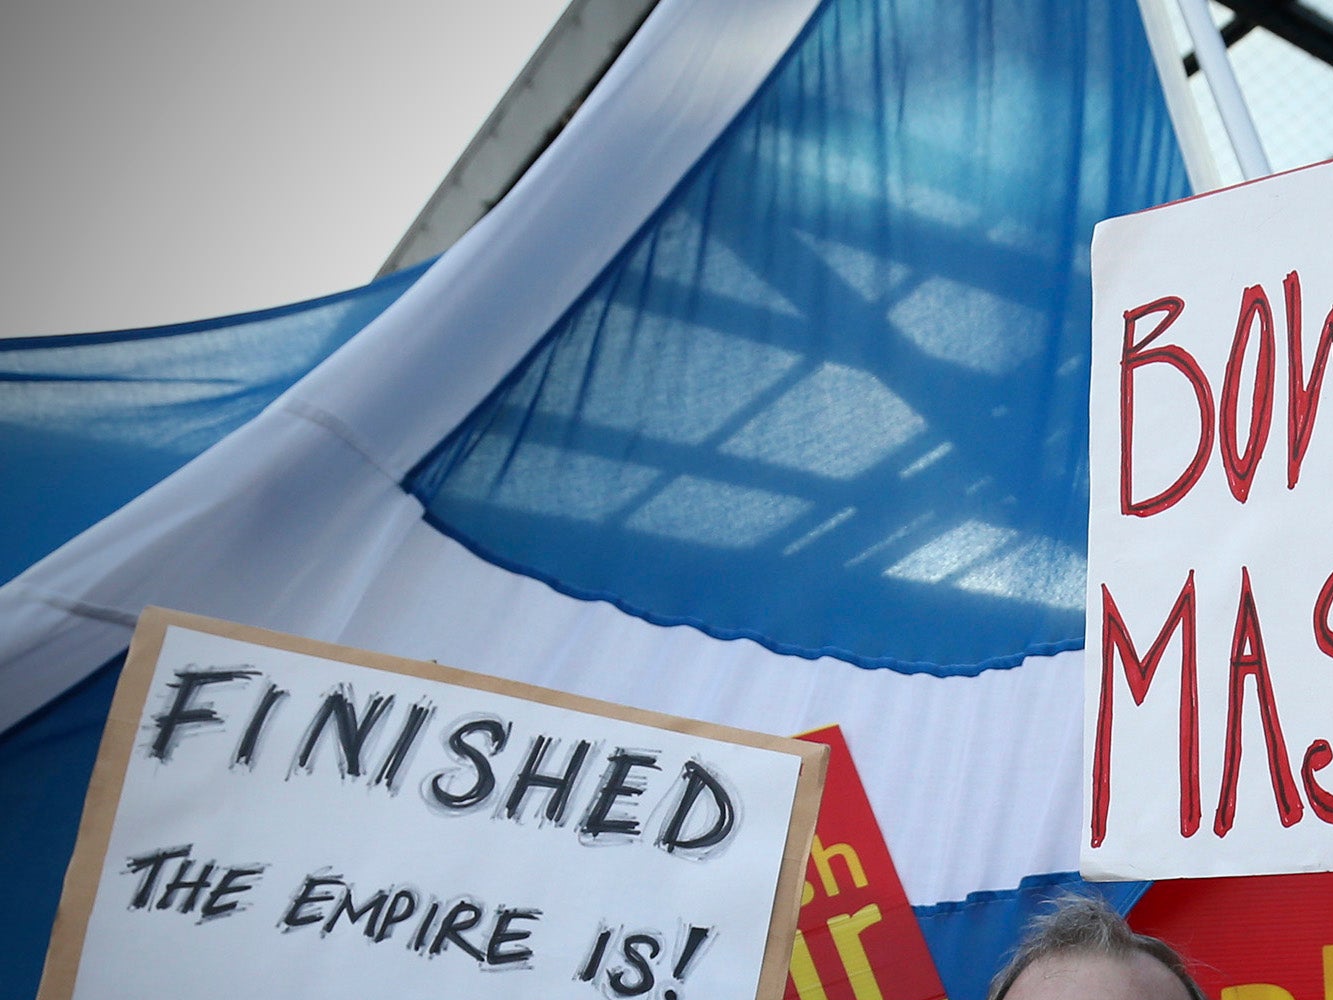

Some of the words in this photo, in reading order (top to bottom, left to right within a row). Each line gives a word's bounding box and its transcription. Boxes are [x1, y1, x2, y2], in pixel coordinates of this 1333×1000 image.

[144, 663, 740, 860] FINISHED
[124, 843, 267, 925] THE
[277, 866, 543, 972] EMPIRE
